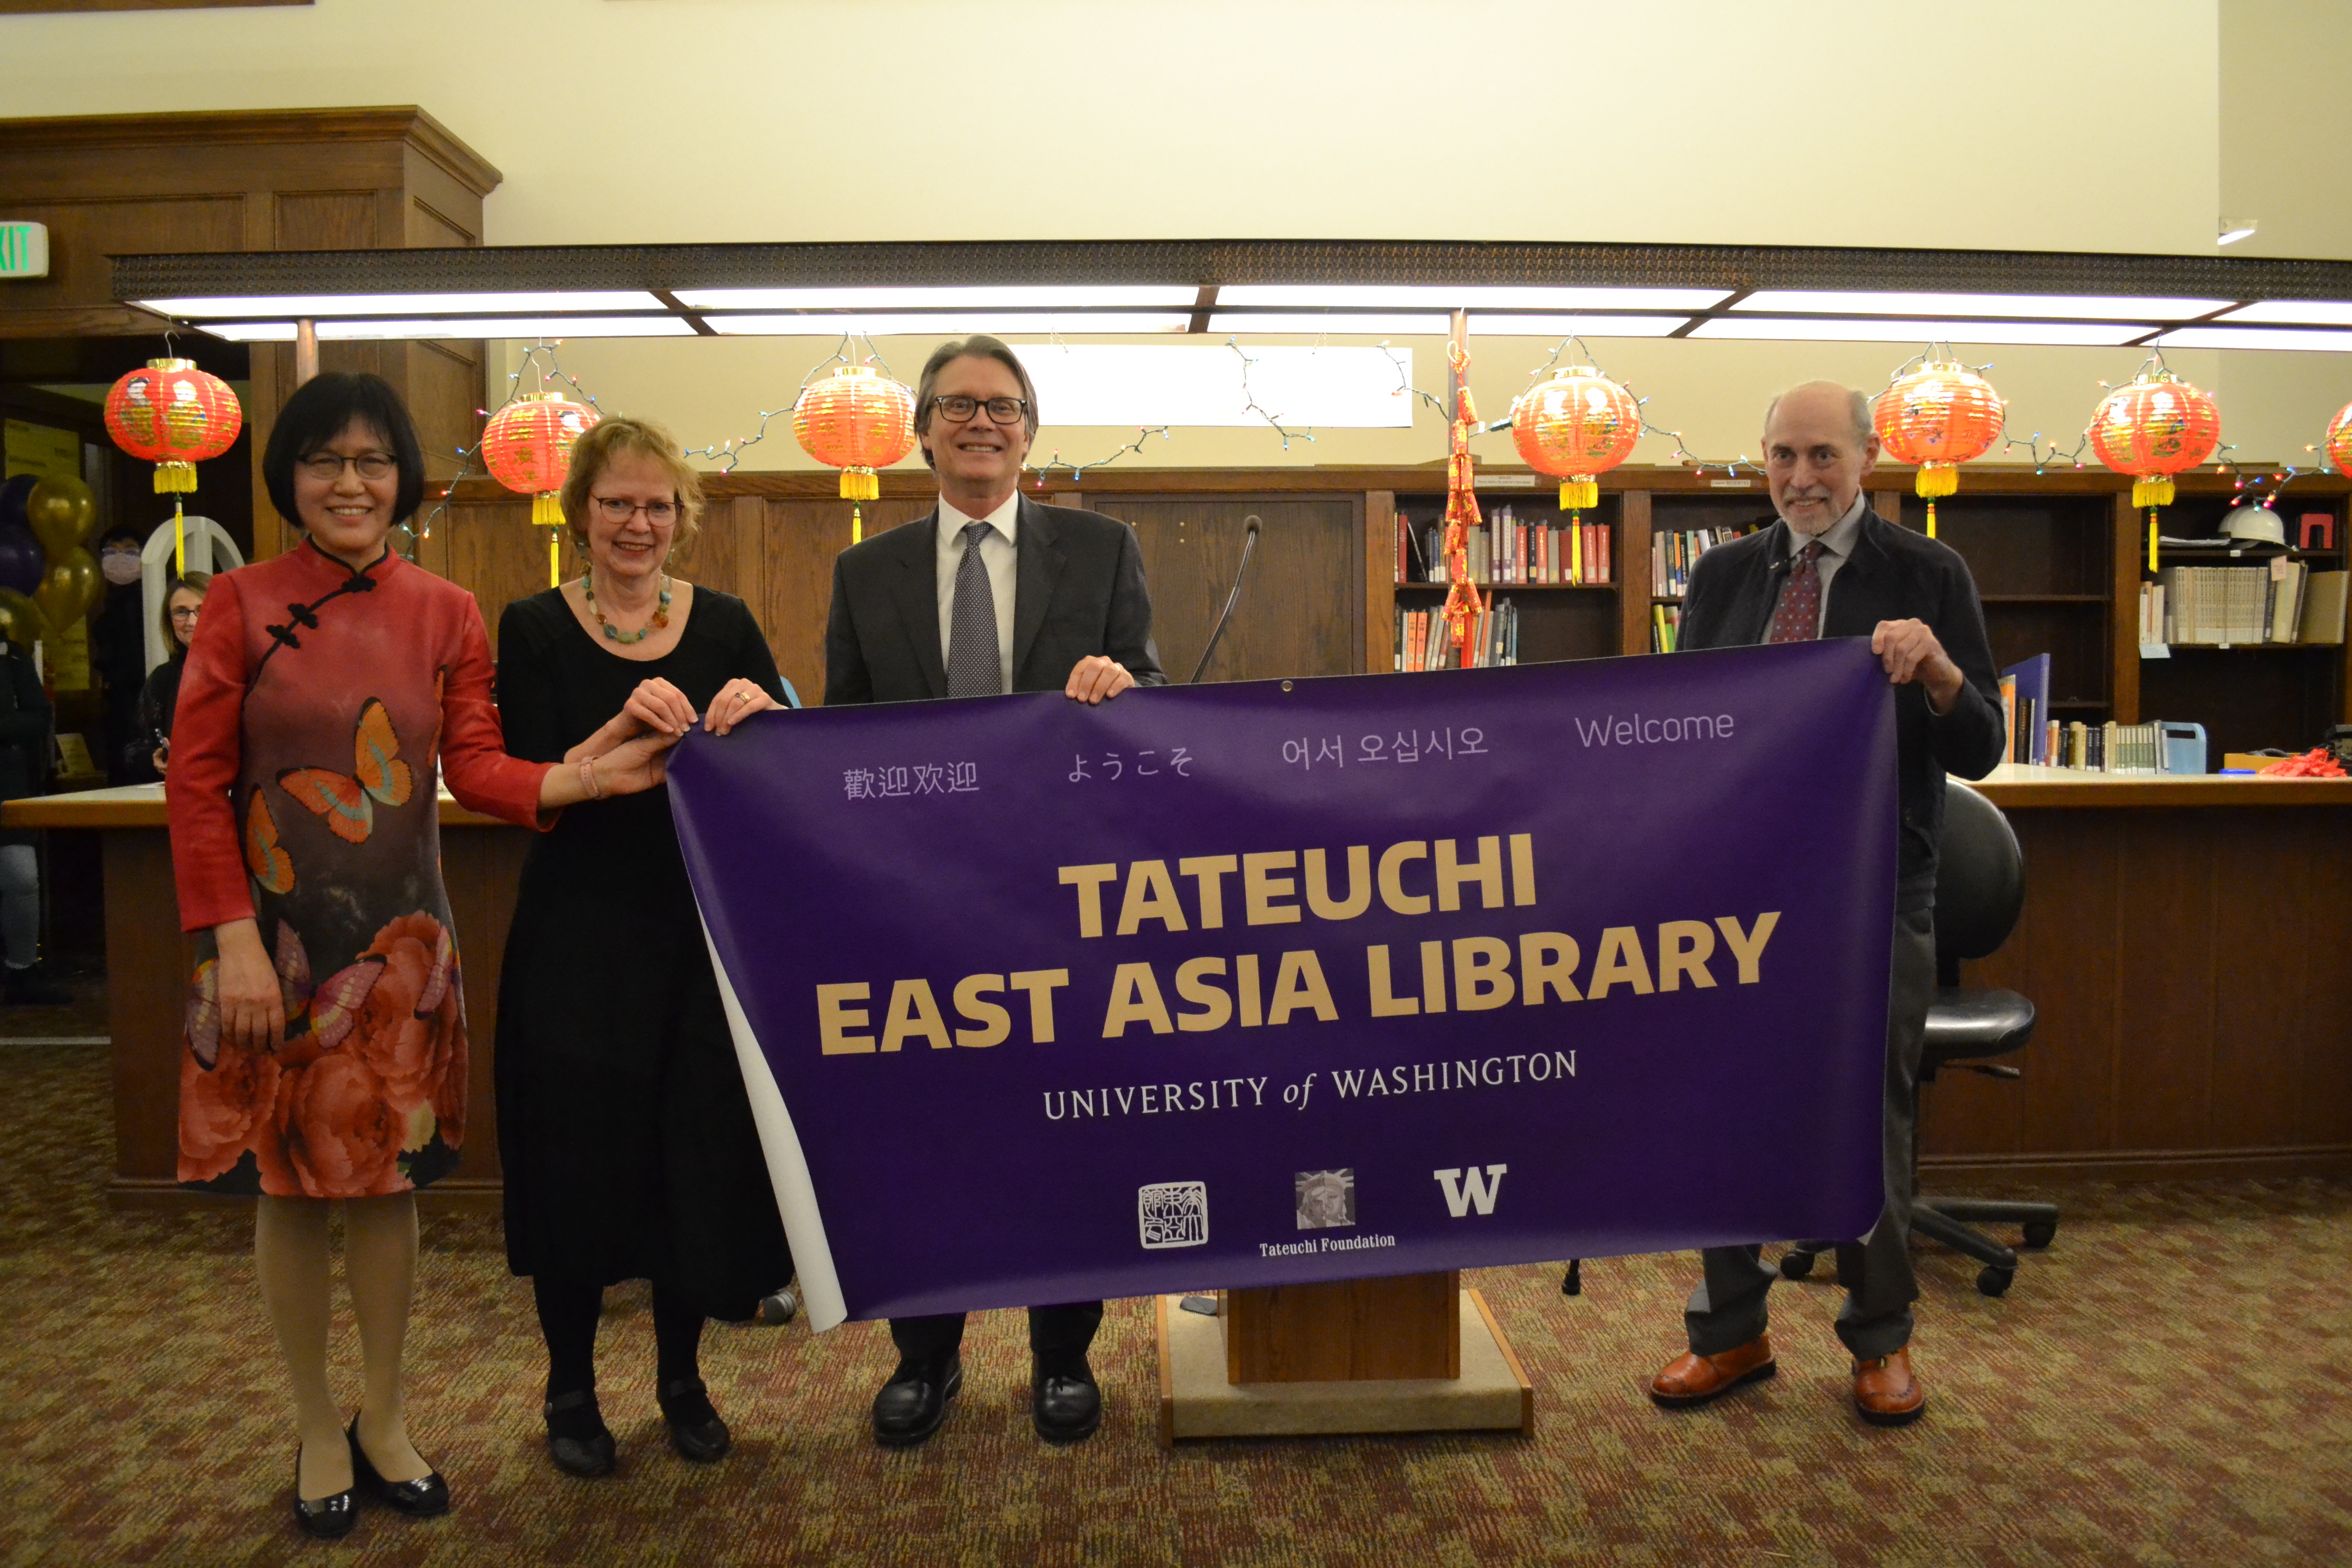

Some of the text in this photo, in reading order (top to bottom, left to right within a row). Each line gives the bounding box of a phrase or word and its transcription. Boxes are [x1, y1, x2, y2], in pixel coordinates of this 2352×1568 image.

[1282, 727, 1489, 770] 어서 오십시오
[1575, 713, 1734, 748] Welcome
[843, 761, 980, 800] 歡迎欢迎
[1068, 747, 1193, 782] ようこそ
[1058, 833, 1536, 938] TATEUCHI
[816, 911, 1782, 1056] EAST ASIA LIBRARY
[1043, 1050, 1577, 1120] UNIVERSITY of WASHINGTON
[1433, 1163, 1508, 1218] W
[1259, 1234, 1396, 1258] Tateuchi Foundation
